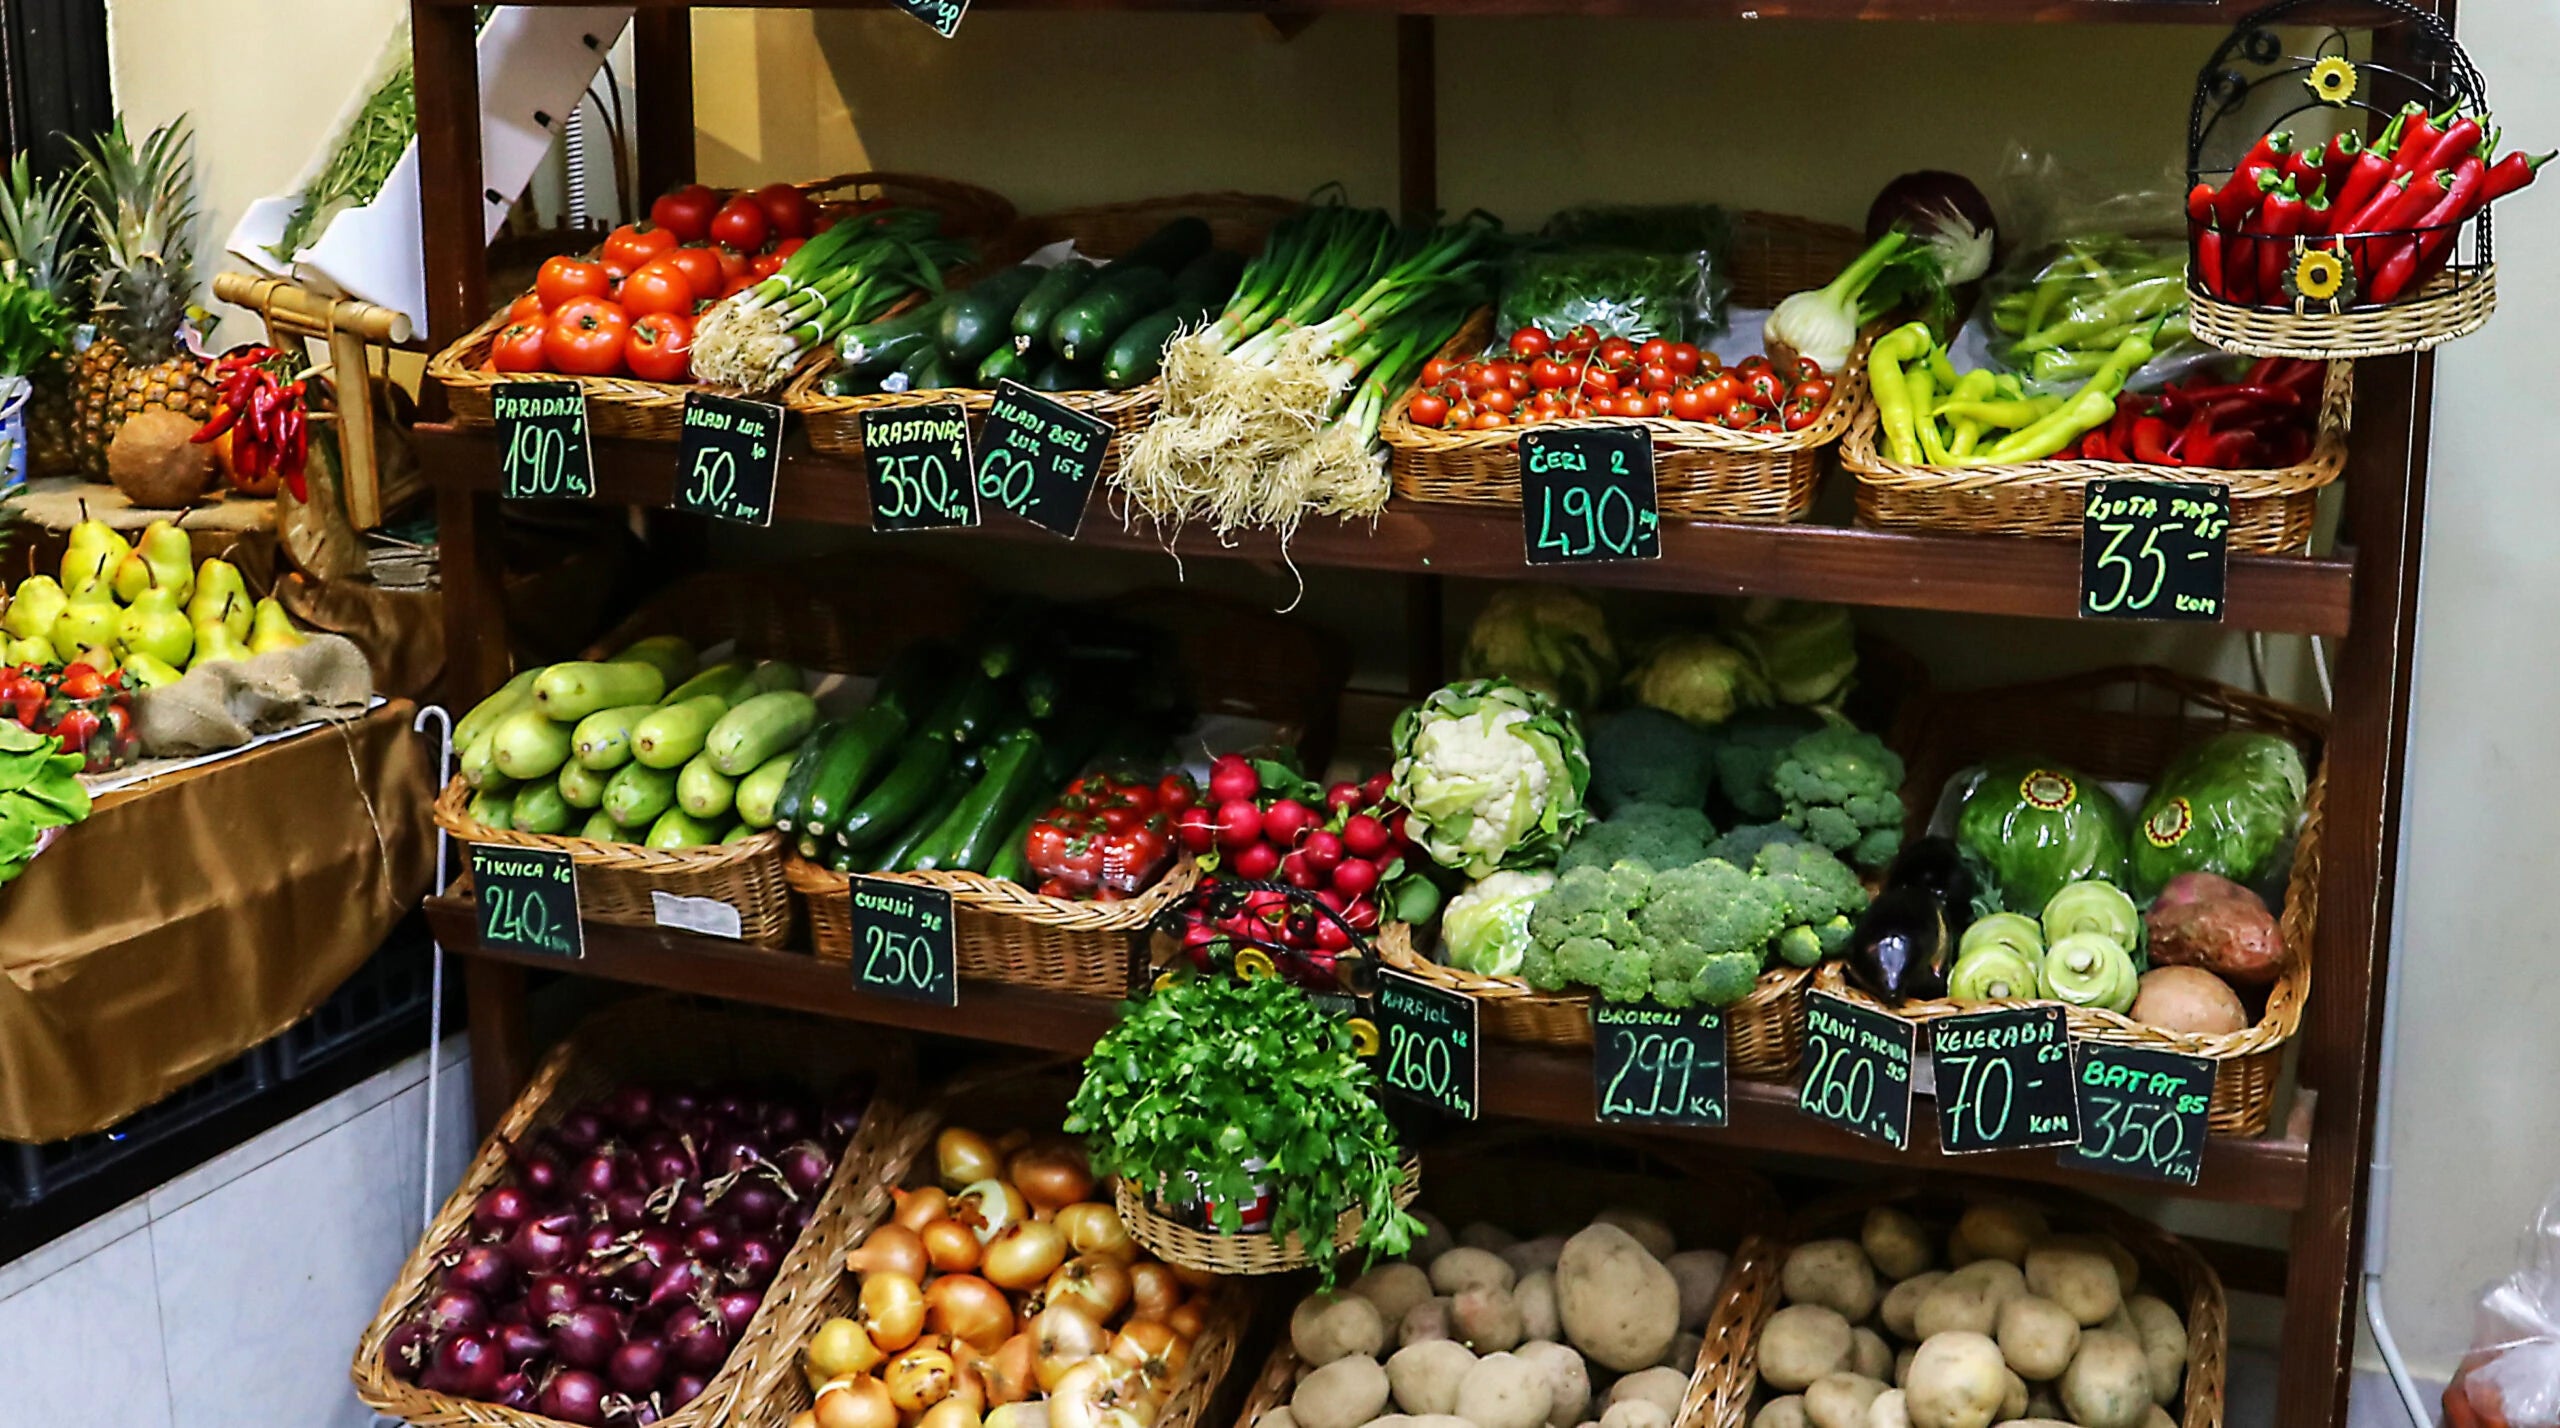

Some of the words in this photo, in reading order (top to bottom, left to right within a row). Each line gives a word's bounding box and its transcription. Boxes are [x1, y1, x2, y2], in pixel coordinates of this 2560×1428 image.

[495, 397, 583, 419] PARADAJZ
[991, 400, 1046, 434] MLADI
[866, 420, 965, 447] KRASTAVAC
[1006, 429, 1041, 456] LUK
[1611, 450, 1630, 475] 2
[2086, 495, 2158, 521] LJUTA
[2194, 518, 2229, 539] 15
[472, 856, 544, 878] TIKVICA
[552, 865, 571, 884] 16
[1382, 990, 1450, 1024] KARFIOL
[1598, 1008, 1681, 1026] BROKOLI
[1935, 1022, 2054, 1053] KELERABA
[2037, 1042, 2068, 1064] 65
[2082, 1060, 2187, 1098] BATAT
[2176, 1094, 2209, 1114] 85
